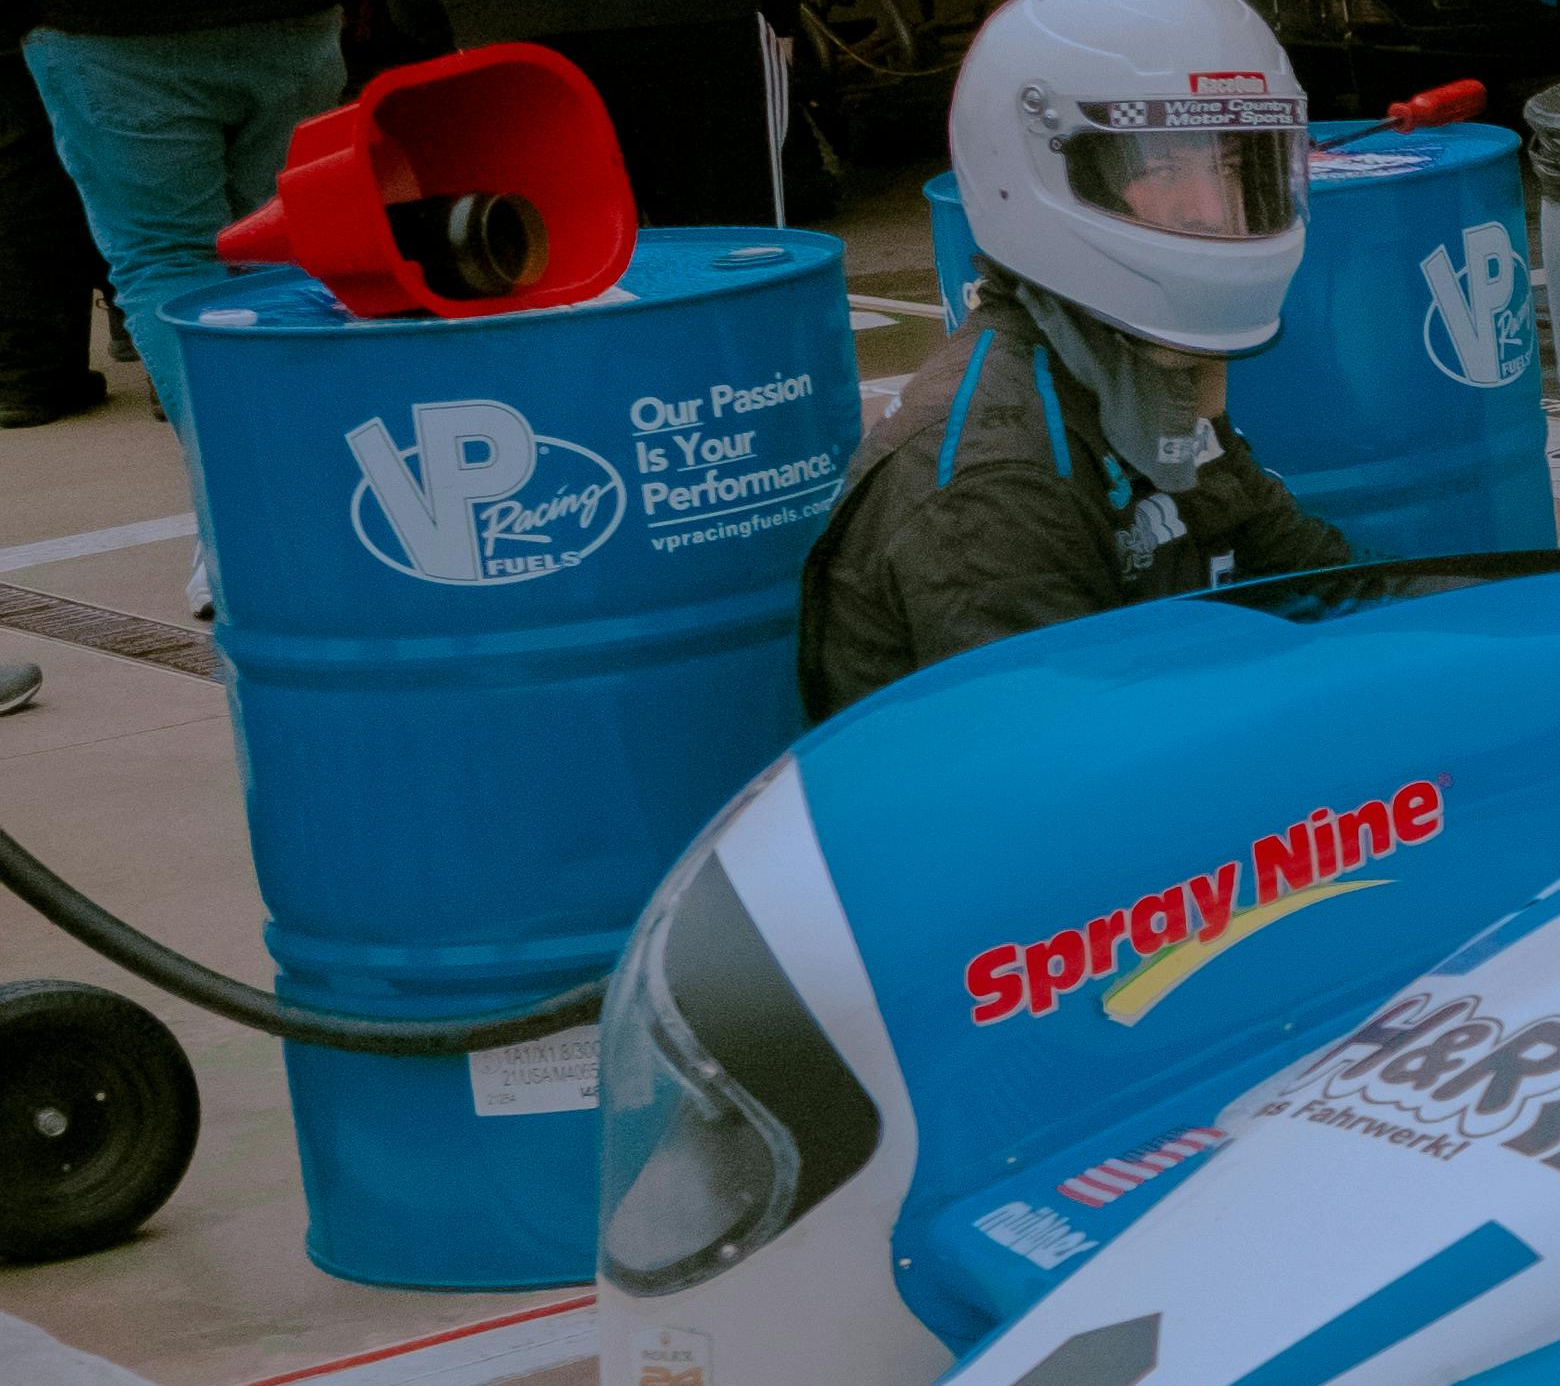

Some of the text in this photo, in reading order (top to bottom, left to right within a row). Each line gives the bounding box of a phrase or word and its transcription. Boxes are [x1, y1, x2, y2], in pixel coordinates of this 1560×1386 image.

[1165, 98, 1292, 116] Wine Country
[1166, 113, 1293, 128] Motor Sports
[1420, 220, 1516, 384] VP
[630, 371, 814, 435] Our Passion
[637, 426, 756, 474] Is Your
[345, 399, 536, 584] VP
[643, 452, 837, 519] Performance.
[480, 486, 605, 557] Racing
[485, 549, 583, 578] FUELS
[965, 778, 1443, 1026] Spray Nine
[1296, 1097, 1472, 1164] Fahrwerk!
